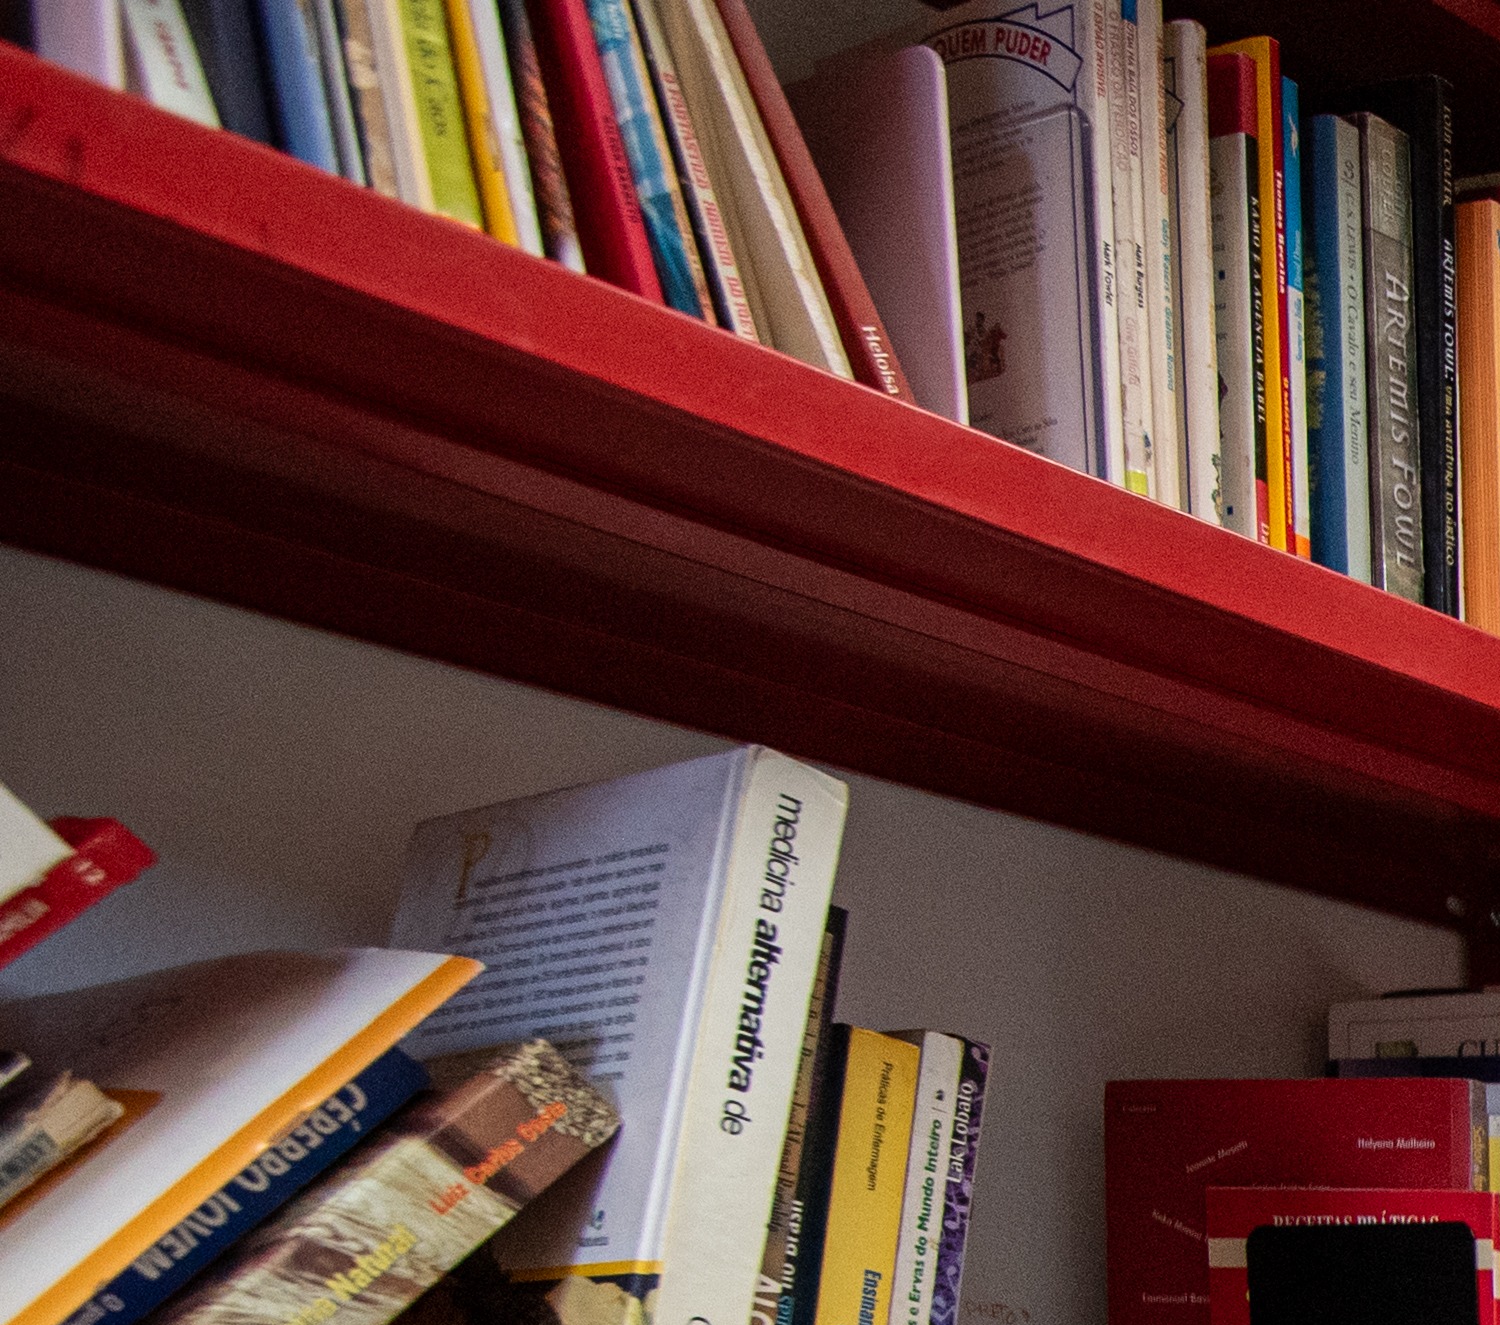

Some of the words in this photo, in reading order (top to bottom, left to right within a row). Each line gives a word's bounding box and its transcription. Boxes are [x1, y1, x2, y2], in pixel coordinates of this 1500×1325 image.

[995, 27, 1052, 66] PUDER
[1130, 120, 1139, 158] OSSOS
[1250, 196, 1259, 247] KAMO
[1274, 170, 1283, 229] Thomas
[1102, 241, 1112, 267] Mark
[1135, 243, 1143, 268] Mark
[1253, 267, 1261, 280] A
[1104, 270, 1115, 306] Fowler
[1135, 270, 1144, 309] Burgess
[1164, 307, 1172, 350] Graham
[1347, 302, 1360, 356] Cavalo
[861, 326, 899, 394] Heloisa
[1383, 271, 1414, 446] ARTEMIS
[1256, 371, 1265, 423] BABEL
[1351, 406, 1362, 463] Menino
[1389, 457, 1418, 568] FOWL
[757, 793, 806, 916] medicina
[719, 916, 780, 1096] alternativa
[240, 1083, 369, 1193] CÉREBRO
[719, 1096, 748, 1137] de
[874, 1108, 886, 1122] de
[949, 1081, 973, 1146] Lobato
[462, 1137, 526, 1185] Carlos
[866, 1124, 885, 1192] Enfermagem
[923, 1119, 942, 1172] Inteiro
[945, 1149, 964, 1183] Lak
[917, 1175, 936, 1231] Mundo
[131, 1197, 244, 1281] JOVEM
[326, 1224, 417, 1303] Natural
[913, 1236, 927, 1257] do
[908, 1260, 926, 1302] Ervas
